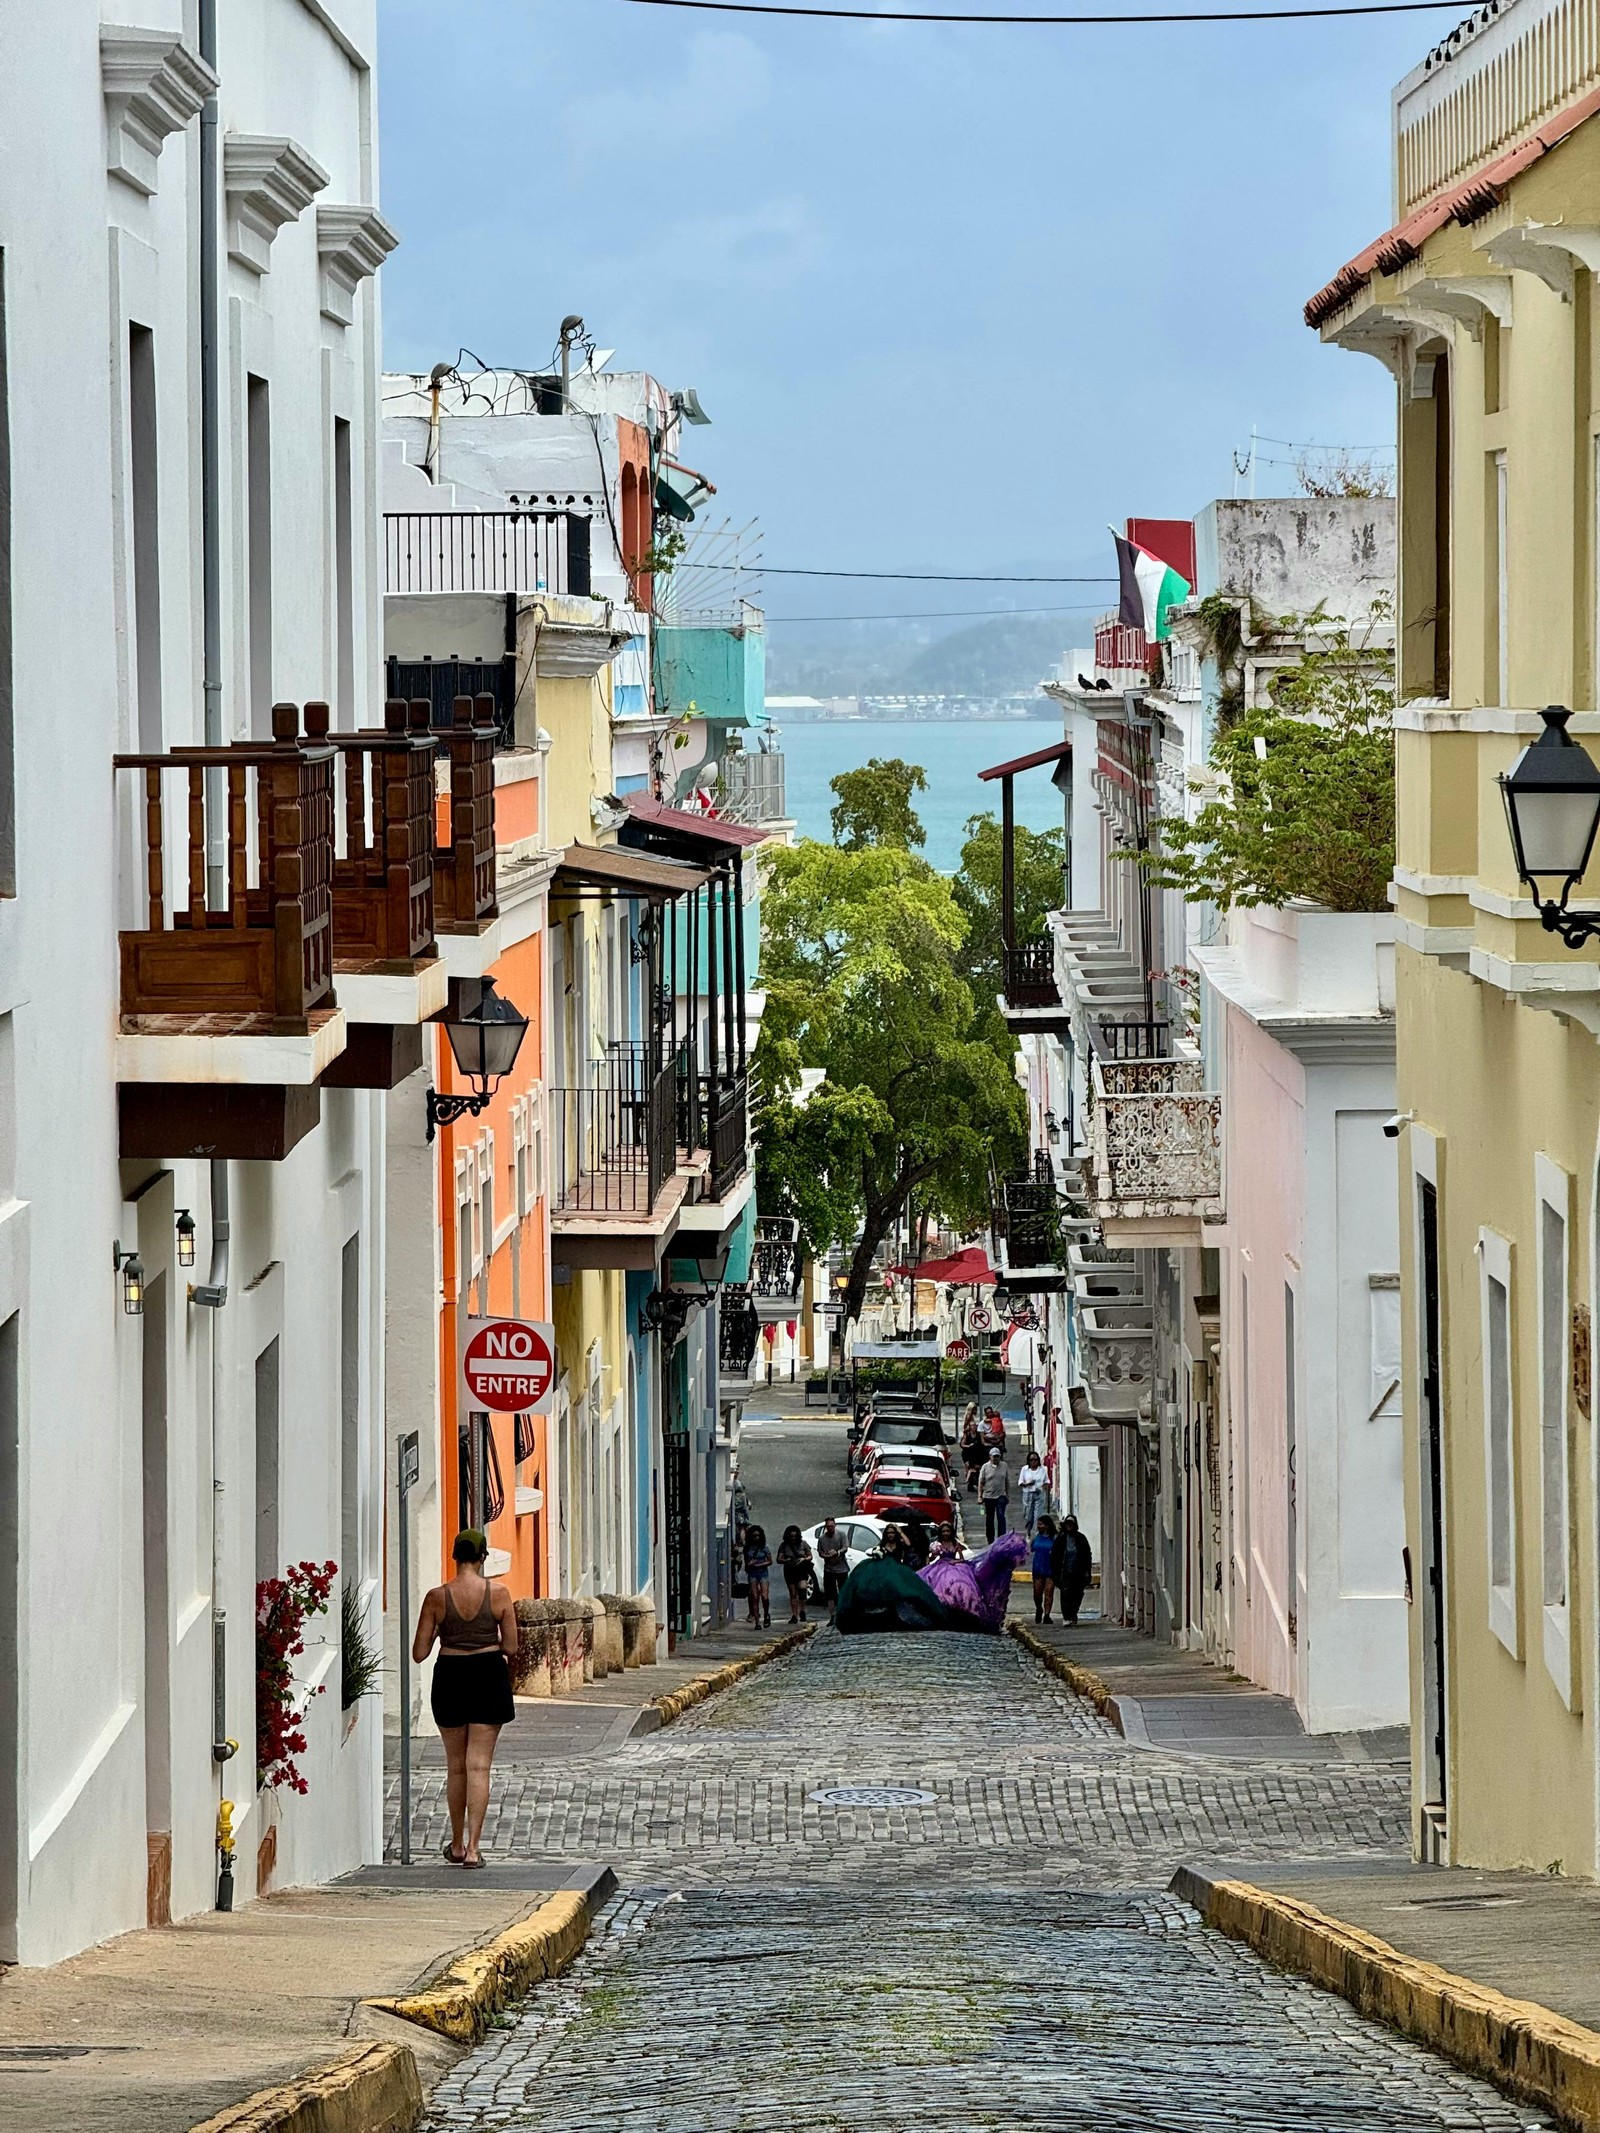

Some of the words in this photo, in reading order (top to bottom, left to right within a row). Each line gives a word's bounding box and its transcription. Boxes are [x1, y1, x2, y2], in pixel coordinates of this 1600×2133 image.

[486, 1331, 533, 1358] NO
[947, 1347, 968, 1357] PARE
[476, 1376, 540, 1396] ENTRE
